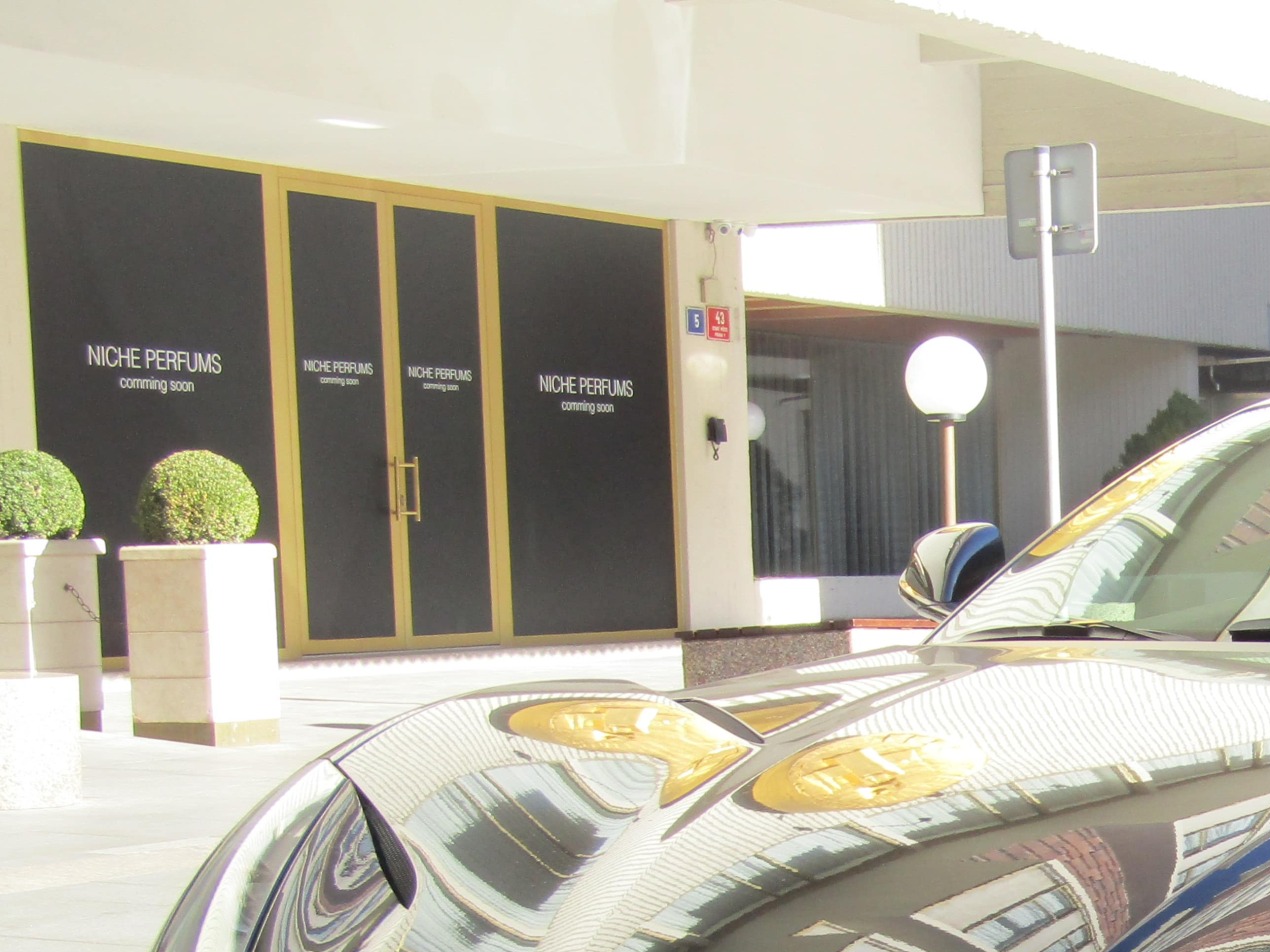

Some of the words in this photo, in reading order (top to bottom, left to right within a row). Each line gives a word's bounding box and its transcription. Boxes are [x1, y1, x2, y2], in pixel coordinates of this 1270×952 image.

[694, 313, 700, 328] 5
[715, 311, 726, 325] 43
[88, 344, 141, 369] NICHE
[145, 349, 222, 374] PERFUMS
[304, 360, 331, 373] NICHE
[333, 361, 374, 375] PERFUMS
[408, 366, 433, 379] NICHE
[435, 368, 473, 382] PERFUMS
[119, 376, 168, 394] comming
[170, 380, 195, 393] soon
[346, 378, 360, 386] soon
[540, 375, 577, 393] NICHE
[579, 377, 634, 398] PERFUMS
[561, 399, 595, 415] comming
[596, 403, 614, 413] soon
